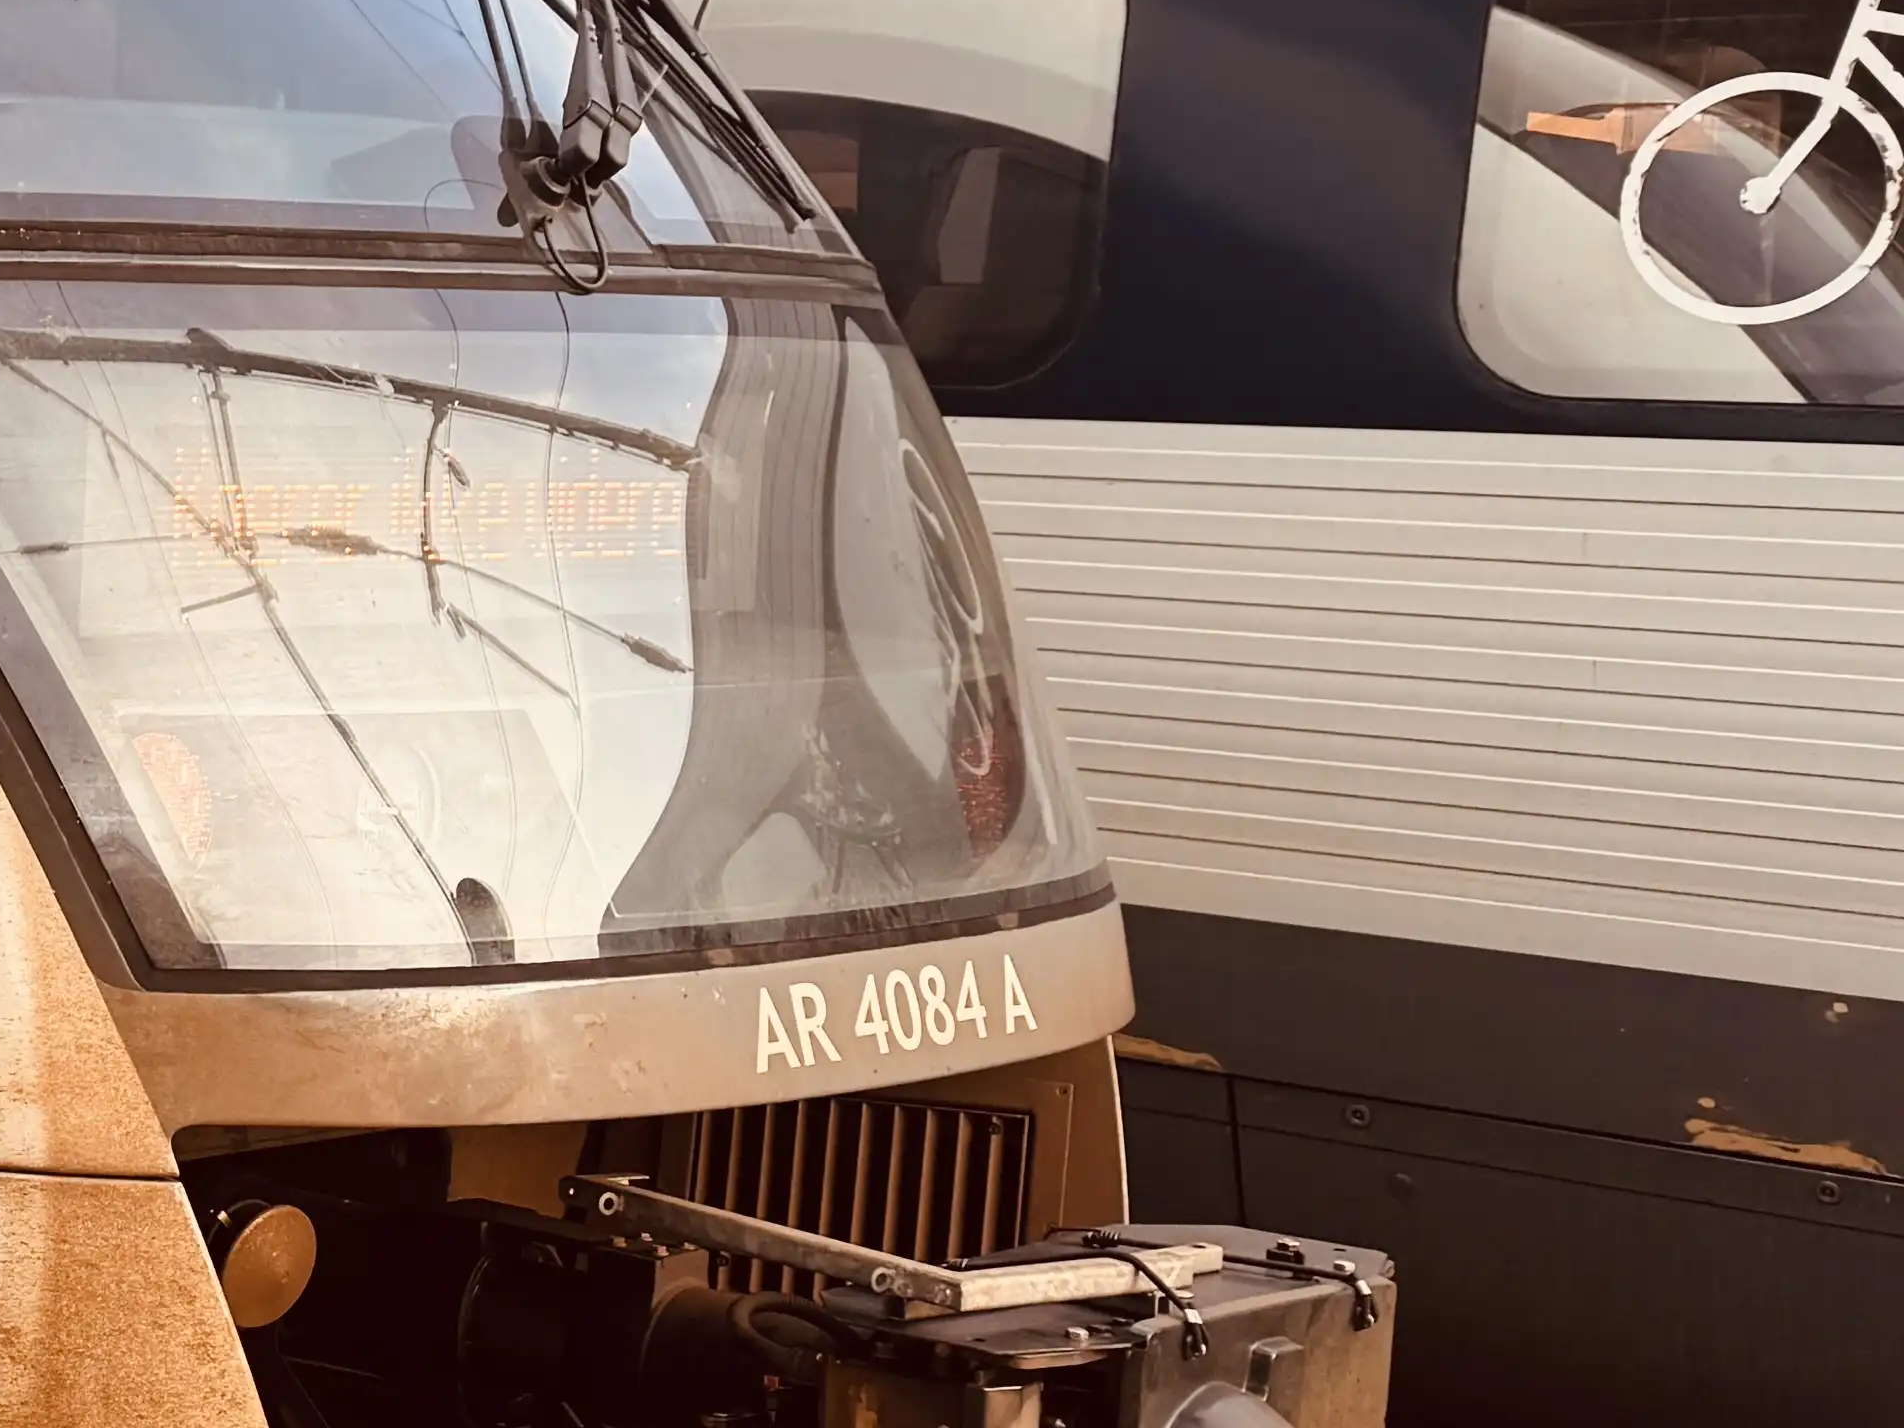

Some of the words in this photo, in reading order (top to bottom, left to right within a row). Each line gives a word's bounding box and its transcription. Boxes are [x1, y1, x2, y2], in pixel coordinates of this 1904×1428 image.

[756, 981, 841, 1074] AR
[854, 959, 988, 1054] 4084
[1003, 953, 1038, 1035] A
